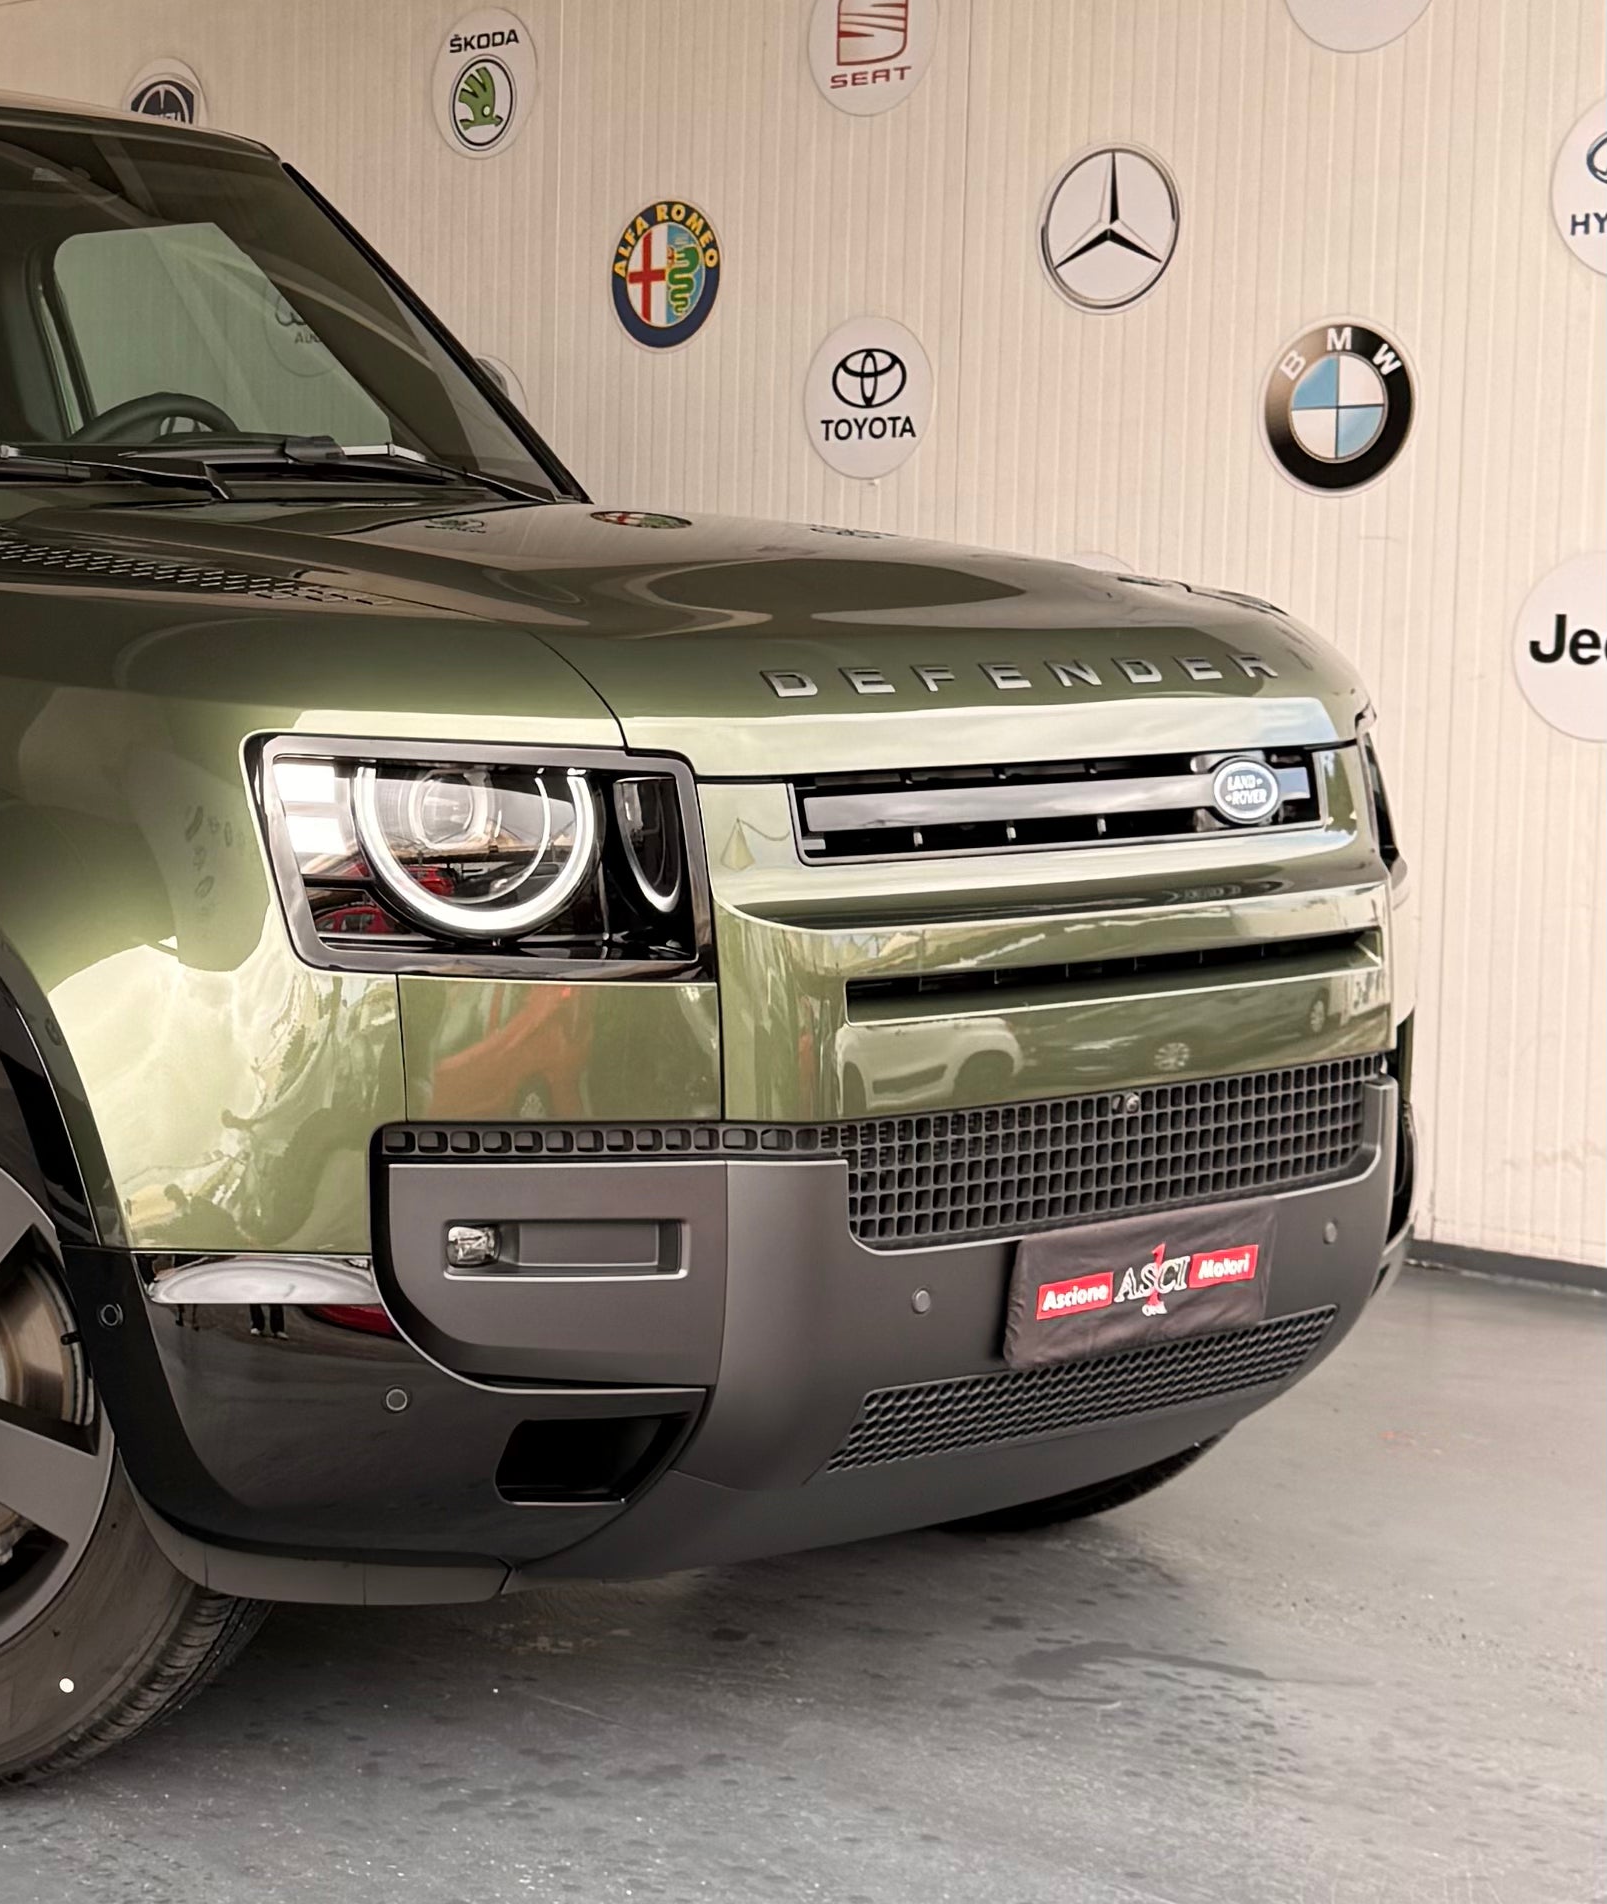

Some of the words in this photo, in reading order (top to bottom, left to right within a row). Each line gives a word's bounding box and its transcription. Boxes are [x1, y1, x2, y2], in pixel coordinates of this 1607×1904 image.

[449, 28, 520, 54] ŠKODA
[830, 65, 912, 90] SEAT
[1570, 212, 1607, 237] HY
[613, 216, 650, 279] ALFA
[656, 204, 719, 269] ROMEO
[1279, 326, 1402, 381] BMW
[820, 415, 917, 442] TOYOTA
[1529, 613, 1607, 666] Je
[760, 652, 1280, 699] DEFENDER
[1227, 774, 1256, 792] LAND
[1231, 787, 1268, 806] ROVER
[1042, 1284, 1109, 1313] Ascione
[1198, 1252, 1251, 1280] Motori
